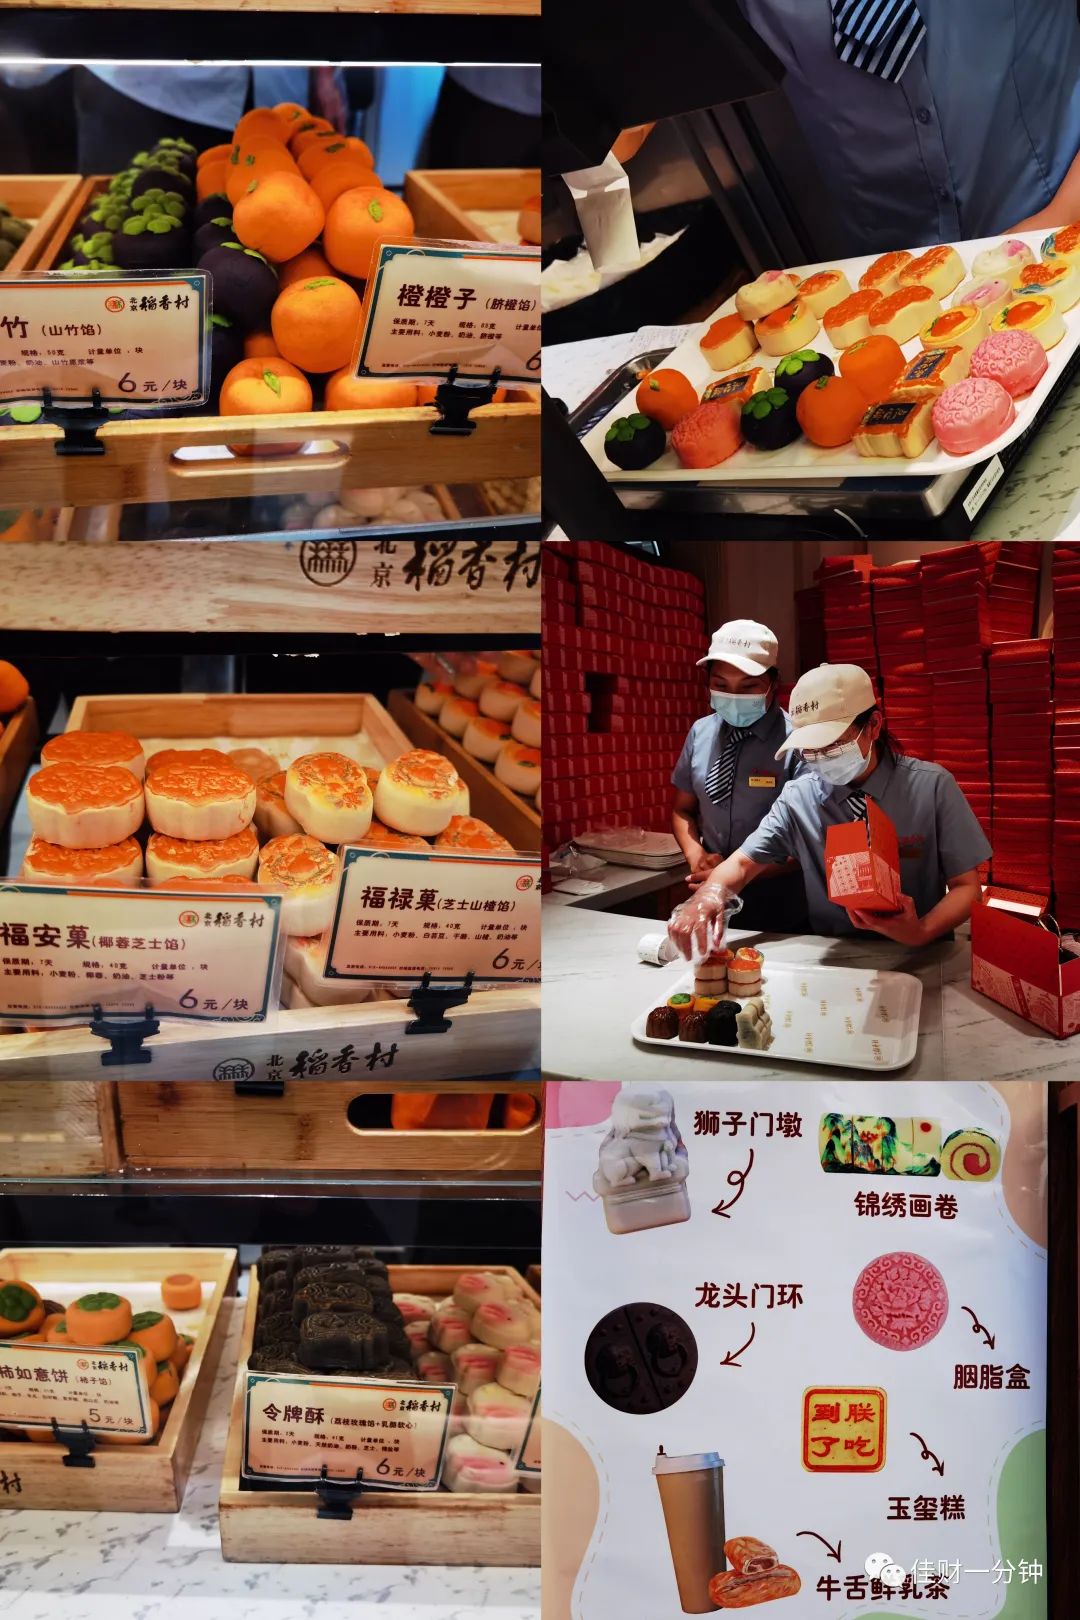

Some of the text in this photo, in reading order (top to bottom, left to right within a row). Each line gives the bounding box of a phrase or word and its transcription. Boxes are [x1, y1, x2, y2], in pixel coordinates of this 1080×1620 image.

[397, 284, 477, 310] 橙橙子
[0, 316, 29, 339] 竹
[289, 1041, 400, 1079] 稻香村
[693, 1110, 803, 1138] 狮子门墩
[853, 1191, 959, 1220] 锦绣画卷
[694, 1281, 804, 1309] 龙头门环
[953, 1363, 1031, 1390] 胭脂盒
[262, 1402, 326, 1425] 令牌酥
[886, 1494, 966, 1521] 玉玺糕
[816, 1574, 951, 1601] 牛舌鲜乳茶
